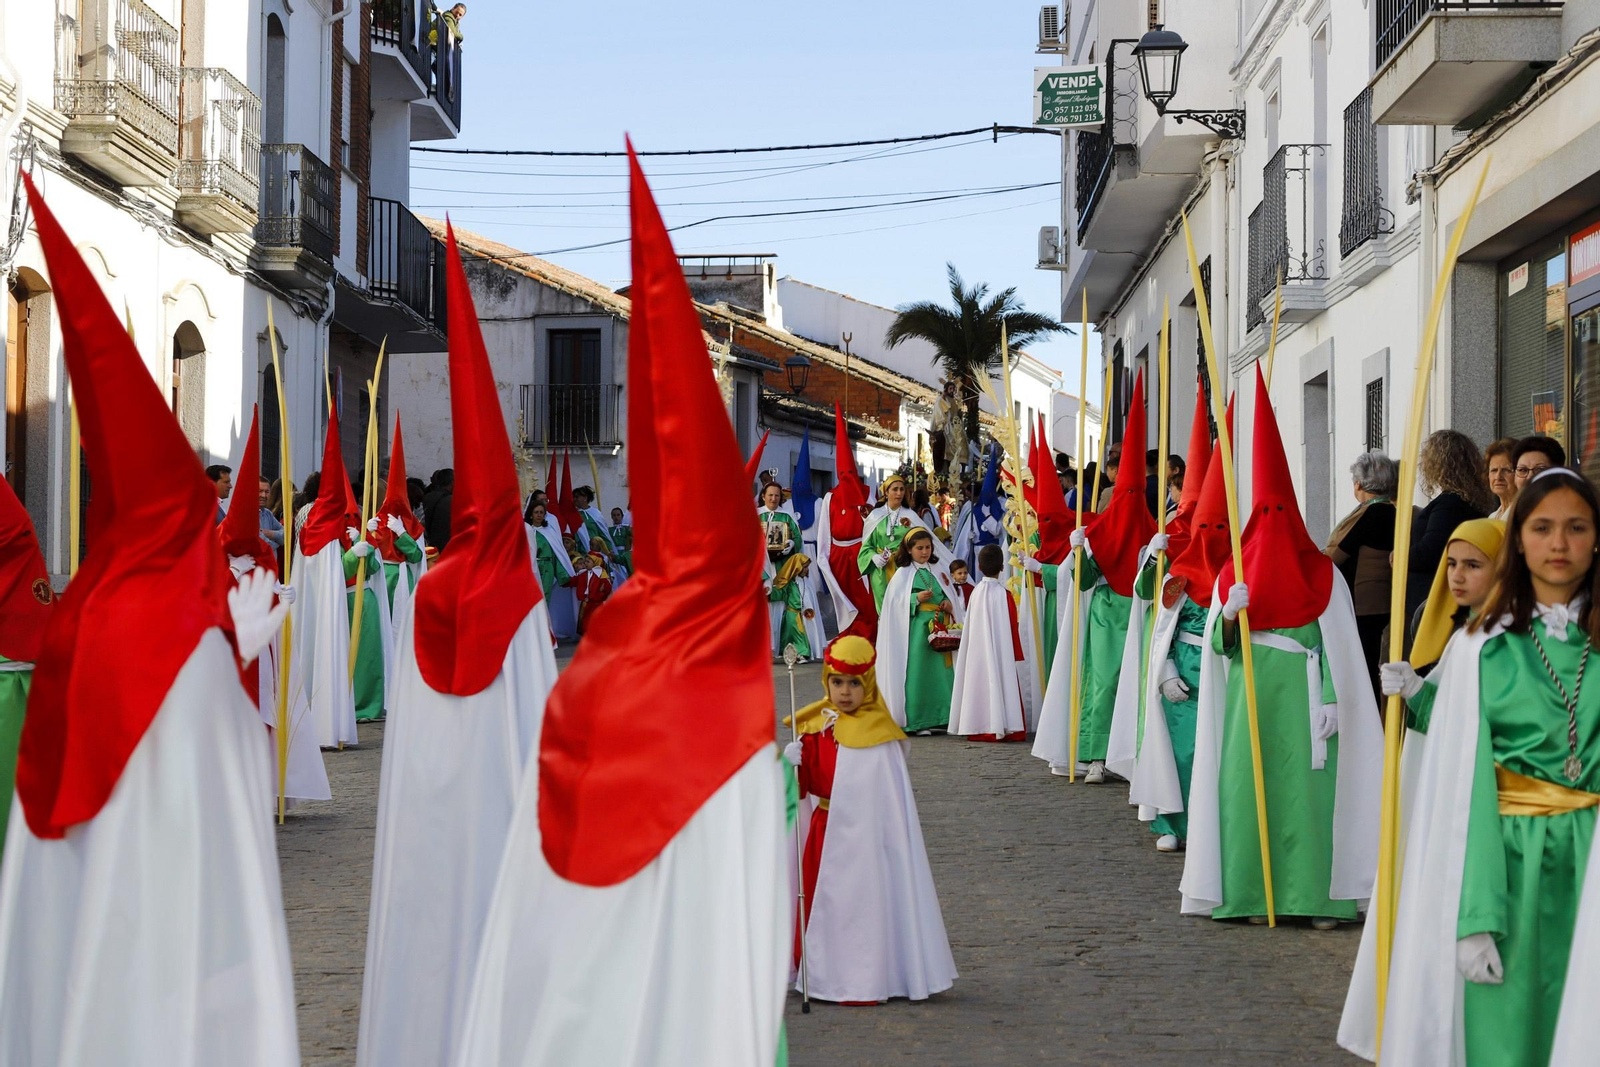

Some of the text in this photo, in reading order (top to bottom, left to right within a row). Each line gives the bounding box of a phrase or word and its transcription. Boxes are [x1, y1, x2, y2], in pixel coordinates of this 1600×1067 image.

[1048, 75, 1096, 89] VENDE
[1055, 113, 1096, 123] 606 791 215
